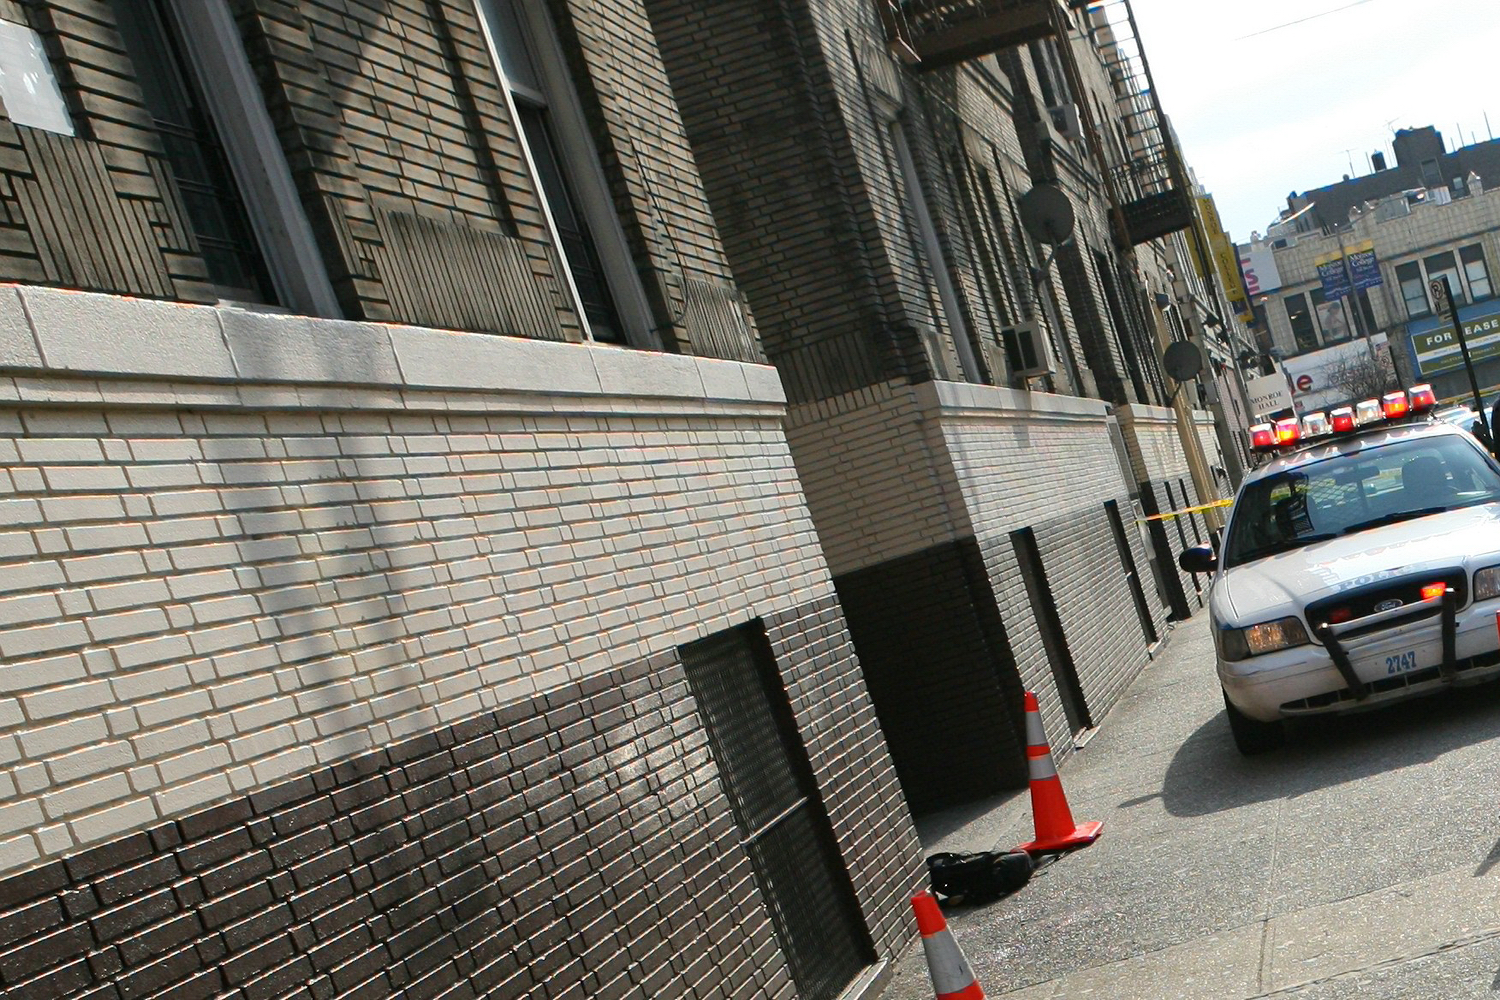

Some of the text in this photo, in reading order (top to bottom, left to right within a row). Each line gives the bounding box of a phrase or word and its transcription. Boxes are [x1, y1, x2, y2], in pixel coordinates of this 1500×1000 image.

[1425, 332, 1453, 346] FOR
[1463, 319, 1500, 336] EASE
[1249, 390, 1283, 404] MONROE
[1258, 400, 1279, 410] HALL
[1385, 650, 1417, 675] 2747
